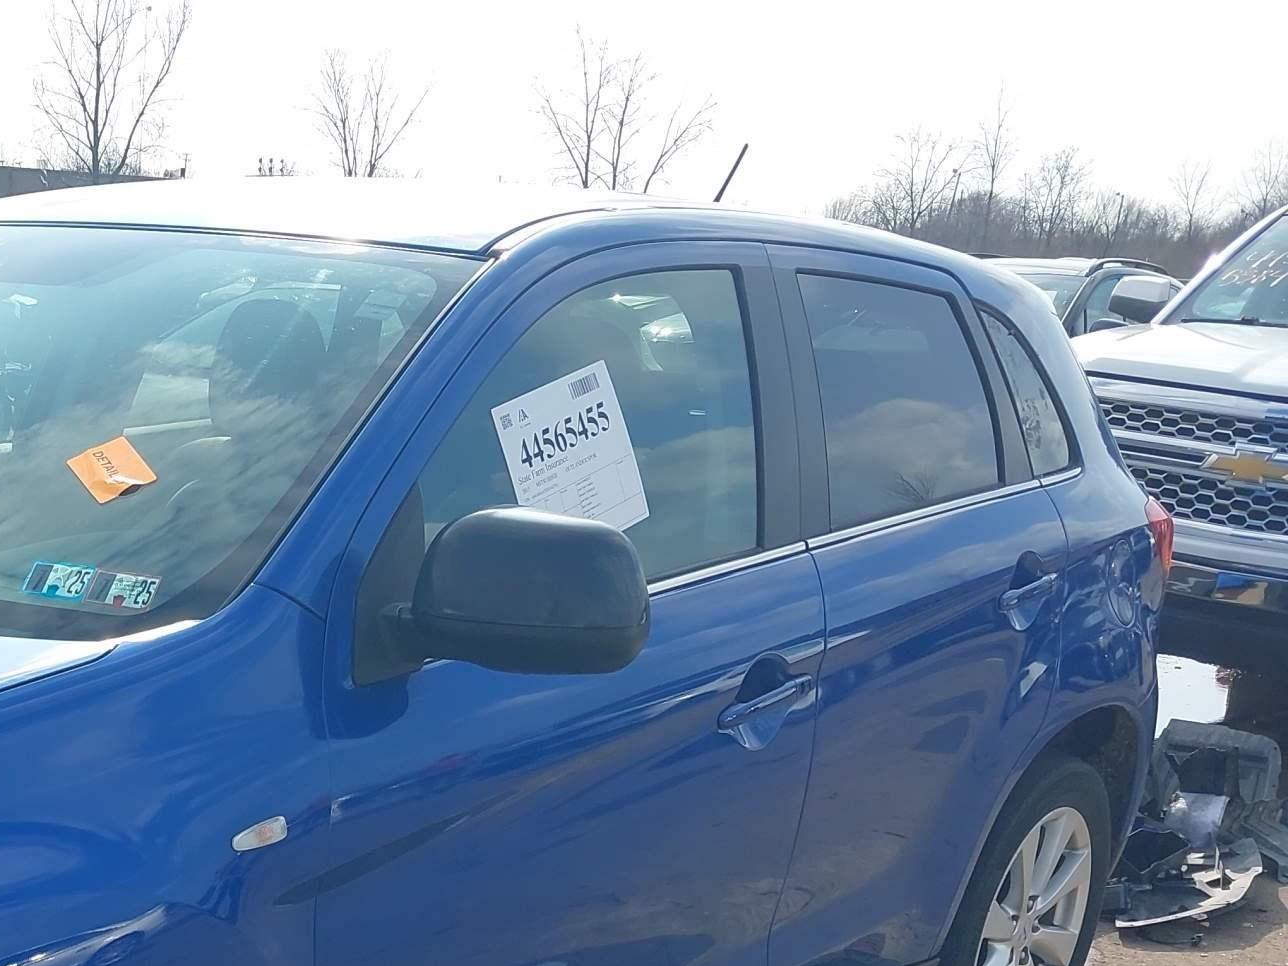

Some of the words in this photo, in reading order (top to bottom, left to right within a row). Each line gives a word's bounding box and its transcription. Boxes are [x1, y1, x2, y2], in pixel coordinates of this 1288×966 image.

[520, 401, 610, 468] 44565455
[92, 450, 120, 477] DETAIL
[66, 570, 91, 595] 25
[133, 579, 157, 606] 25
